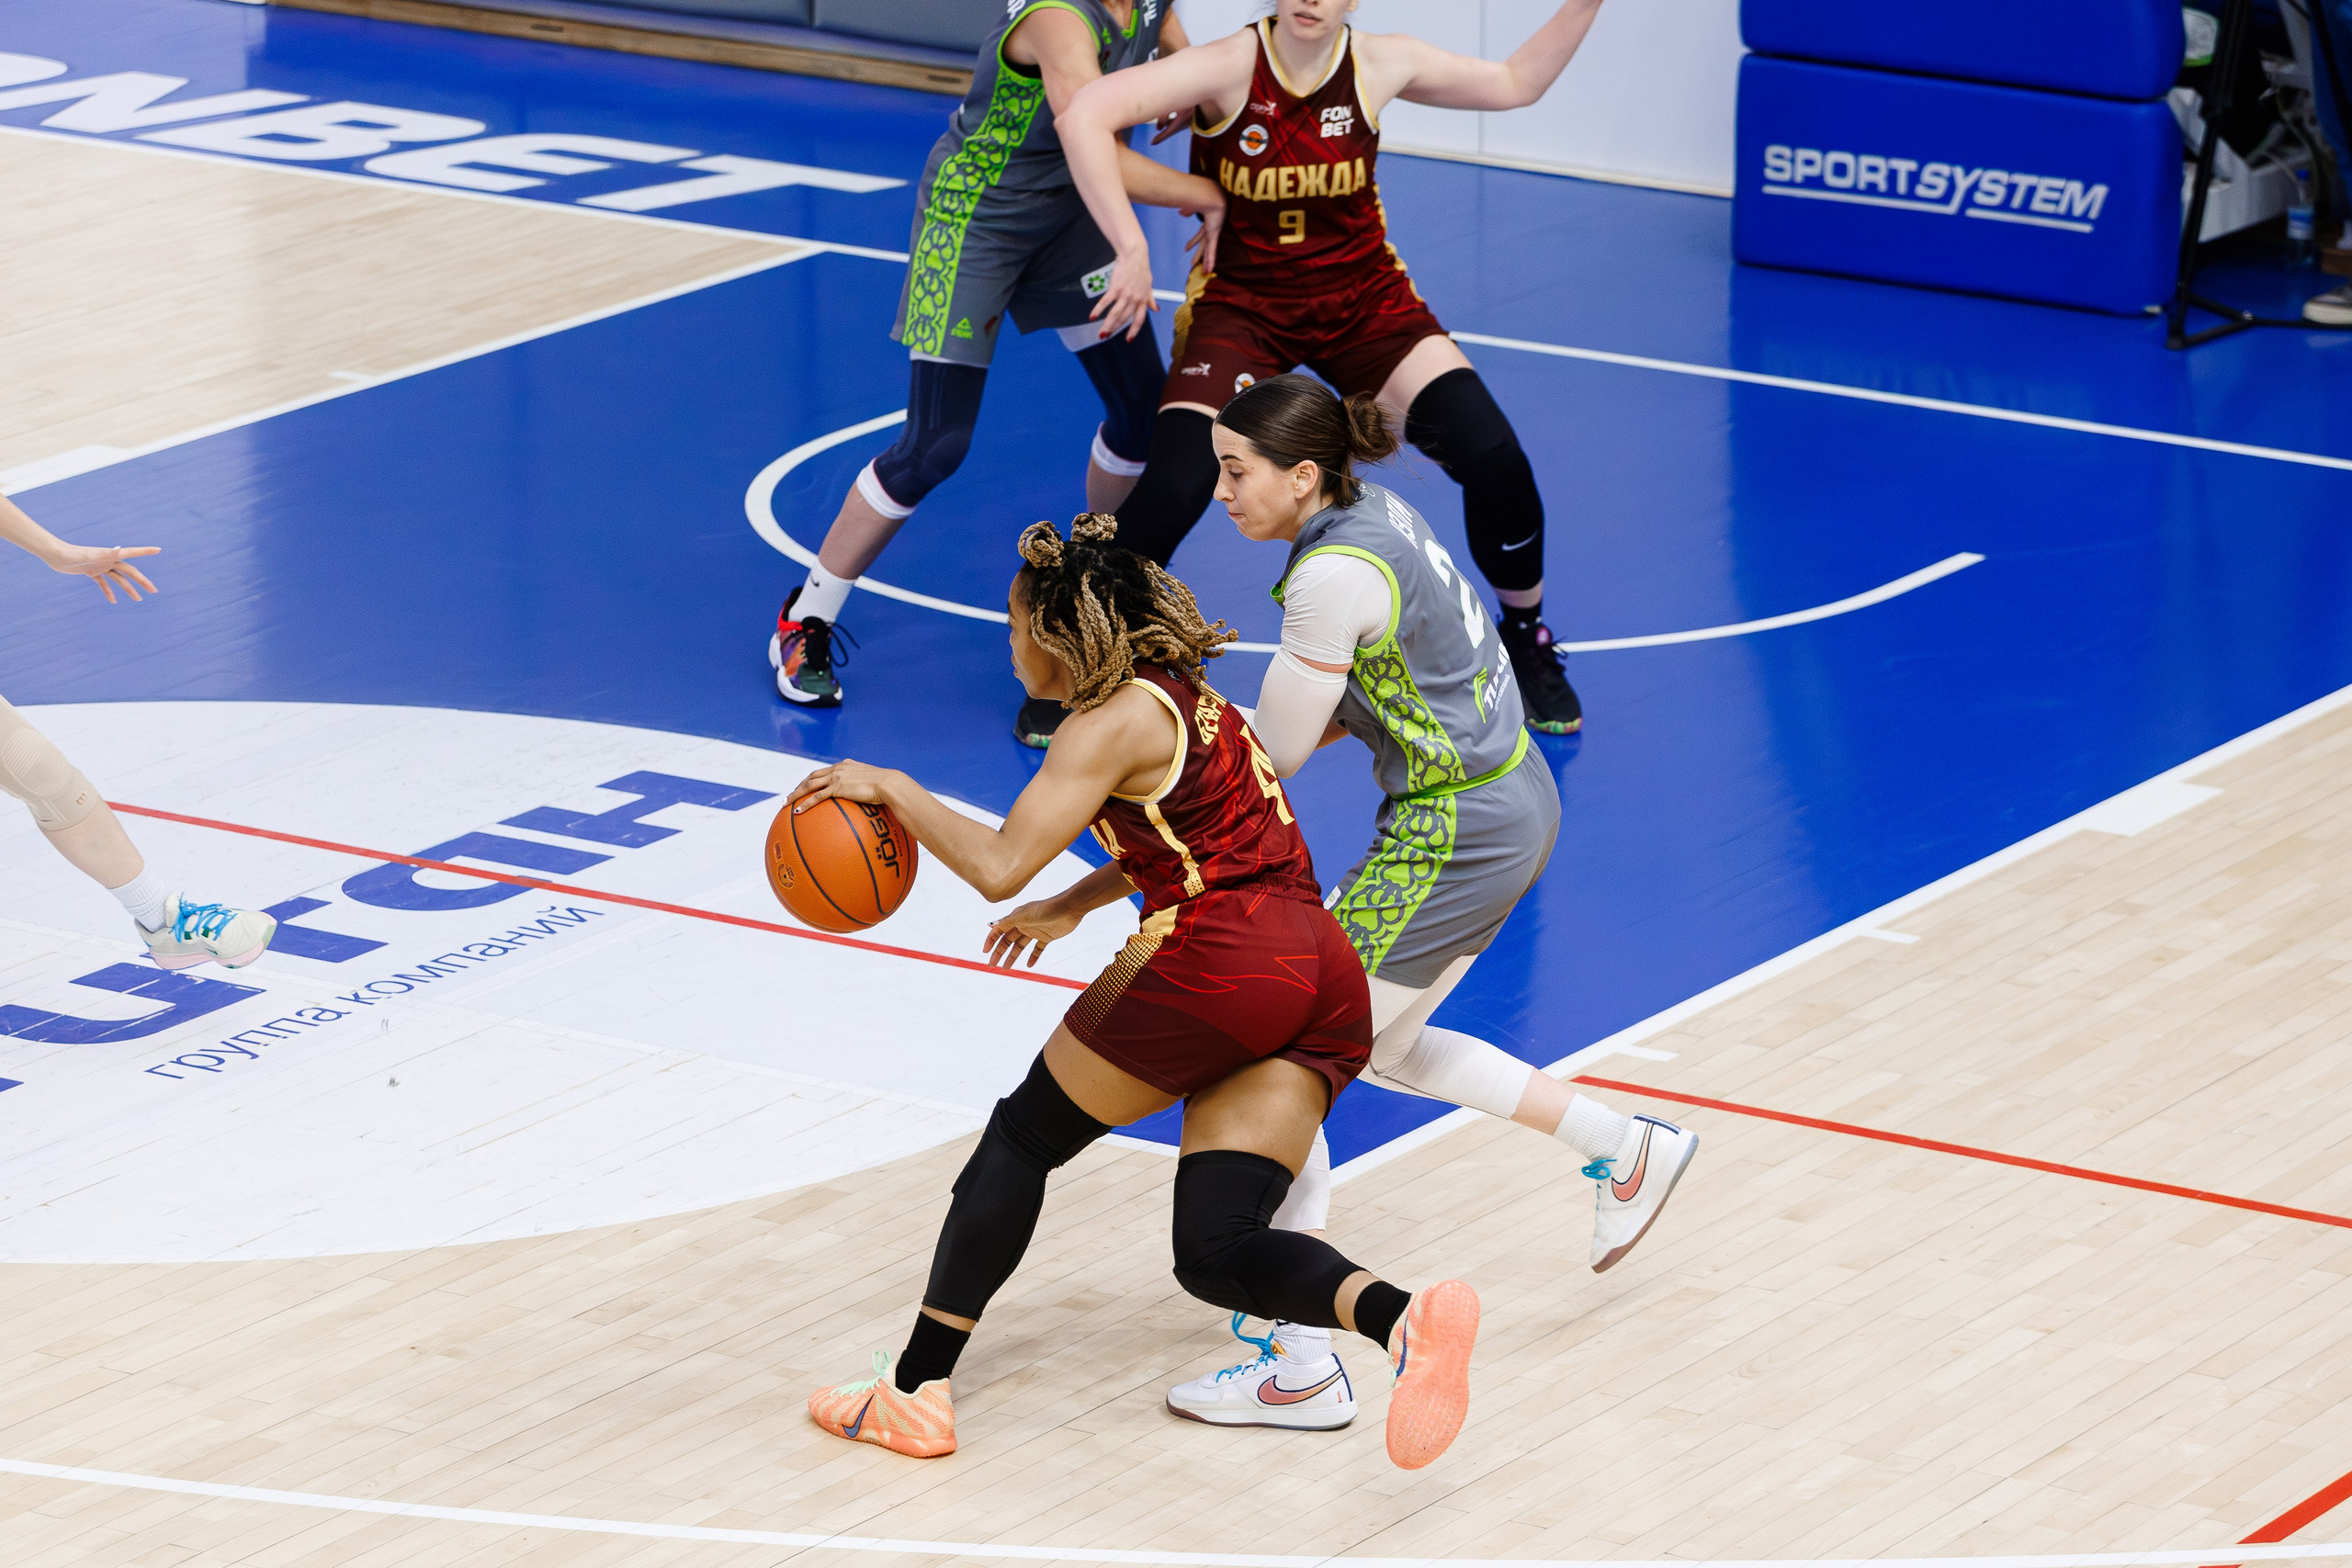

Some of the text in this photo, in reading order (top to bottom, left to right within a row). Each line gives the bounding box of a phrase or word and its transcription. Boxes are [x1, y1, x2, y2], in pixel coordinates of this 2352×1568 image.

[1320, 104, 1352, 123] FON
[1320, 118, 1355, 138] BET
[1220, 157, 1366, 201] НАДЕЖДА
[1278, 209, 1306, 244] 9
[859, 804, 899, 878] JÖGE
[0, 770, 779, 1092] итан
[143, 906, 605, 1079] группа компаний
